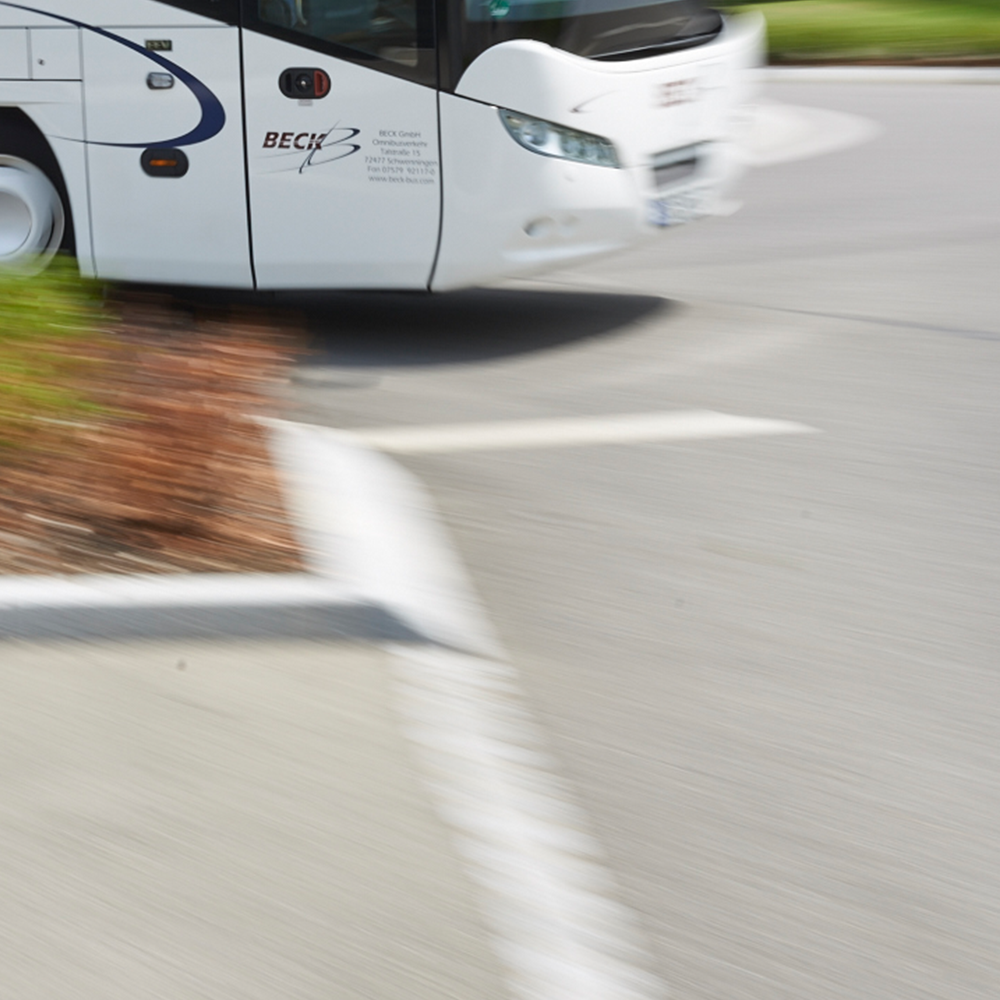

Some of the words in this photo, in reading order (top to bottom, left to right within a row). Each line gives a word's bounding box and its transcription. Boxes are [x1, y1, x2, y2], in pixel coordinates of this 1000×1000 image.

[262, 131, 328, 151] BECK
[372, 139, 428, 148] Omnibusverkehr
[387, 158, 439, 167] Schwenningen
